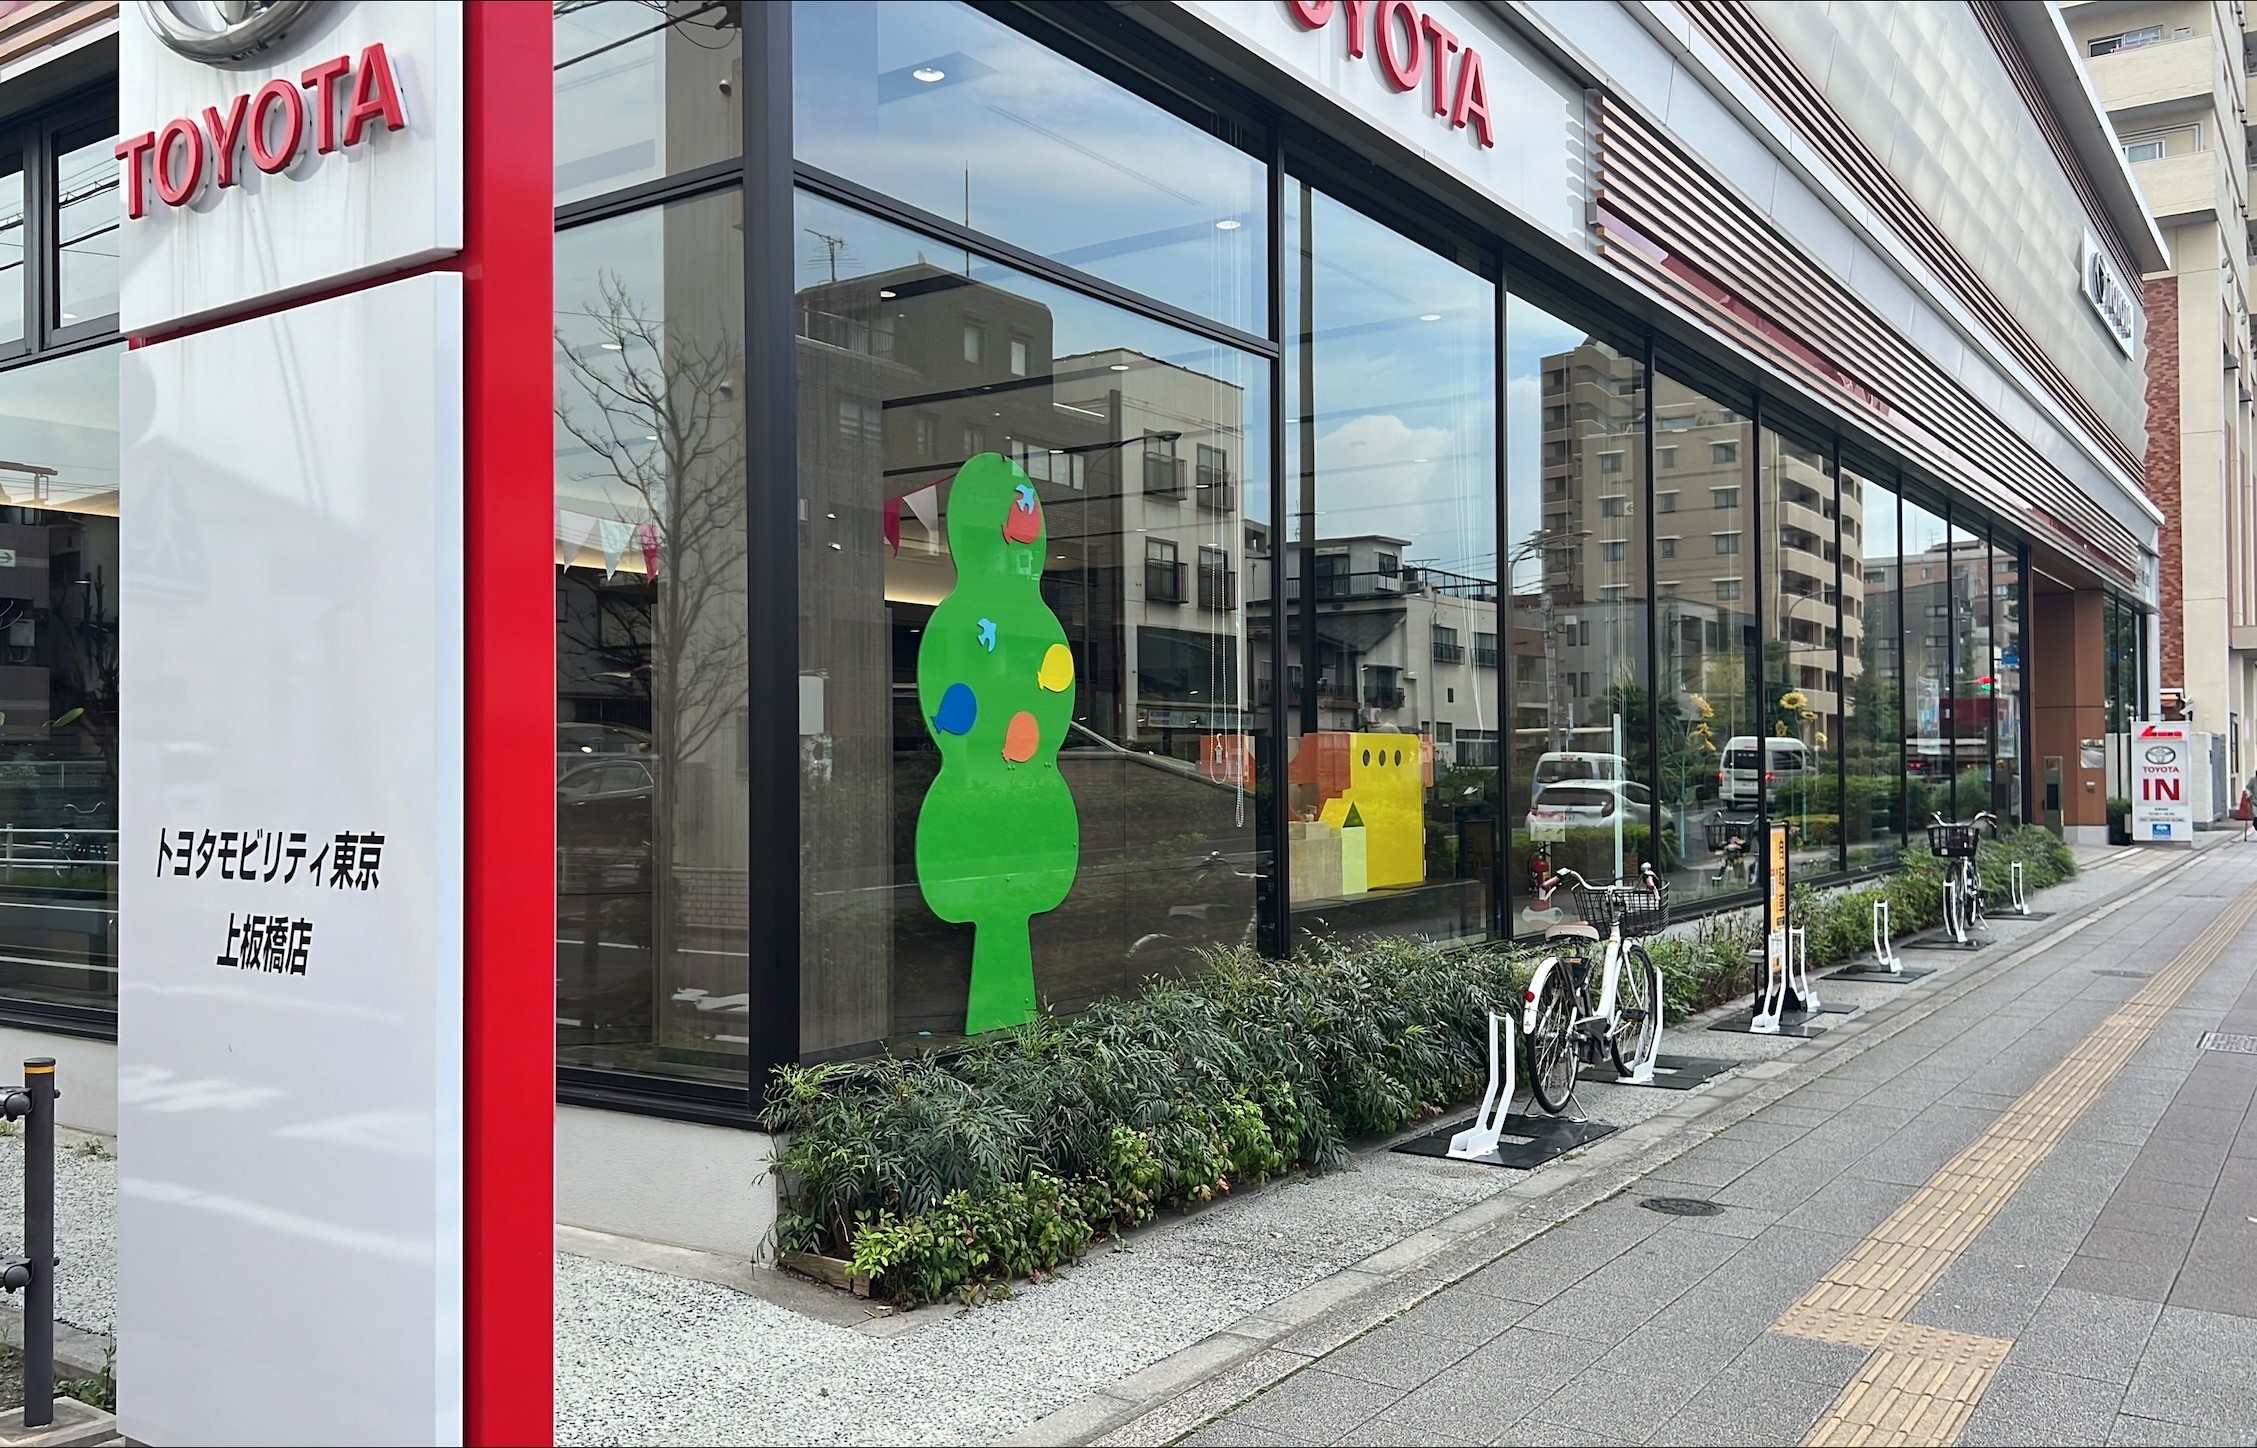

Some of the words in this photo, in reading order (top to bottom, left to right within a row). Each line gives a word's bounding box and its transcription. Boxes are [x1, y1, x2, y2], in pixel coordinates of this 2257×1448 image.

[115, 42, 404, 219] TOYOTA
[2143, 778, 2180, 800] IN
[157, 828, 385, 891] トヨタモビリティ東京
[217, 912, 313, 976] 上板橋店
